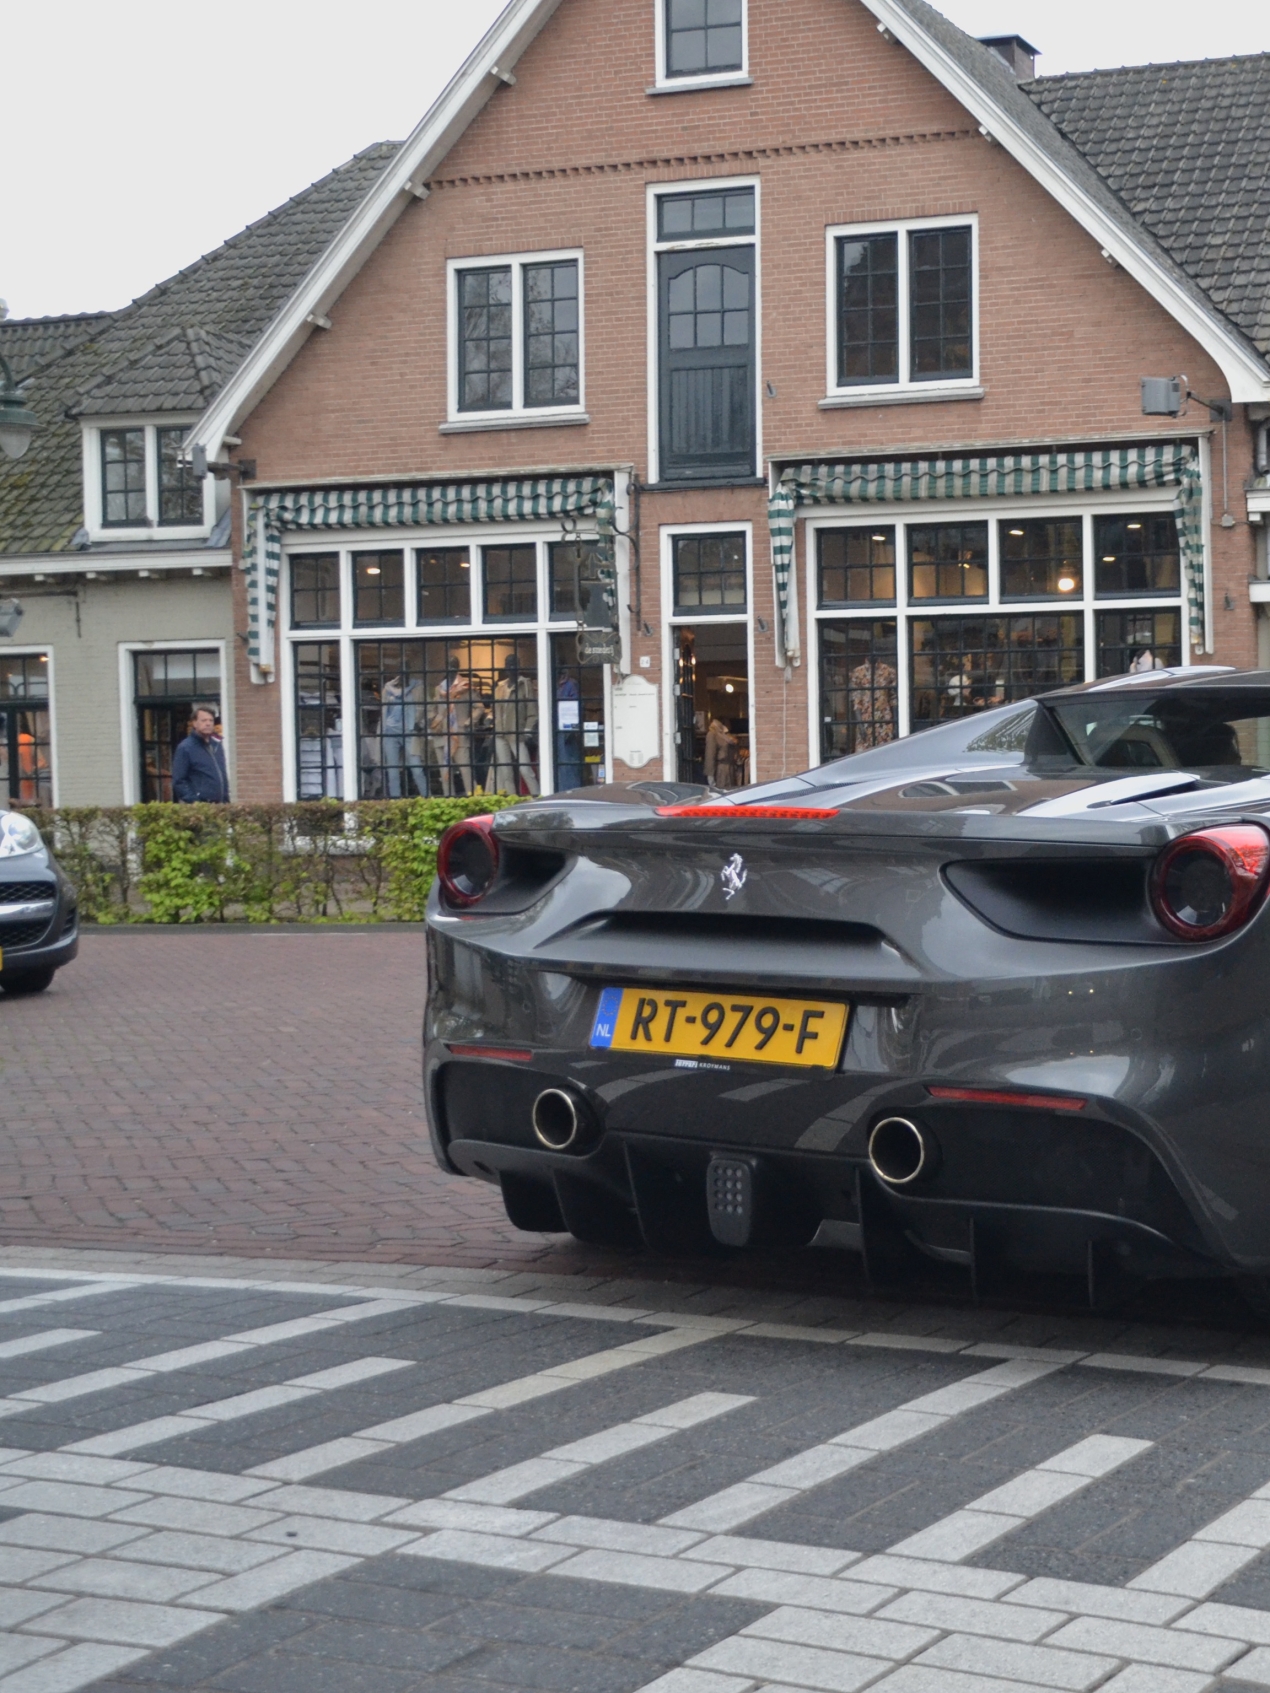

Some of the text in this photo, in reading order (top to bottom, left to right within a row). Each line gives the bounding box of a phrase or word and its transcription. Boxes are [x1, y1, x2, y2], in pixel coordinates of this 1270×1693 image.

[595, 1023, 611, 1037] NL
[630, 997, 825, 1054] RT-979-F
[699, 1062, 731, 1071] KROYMANS
